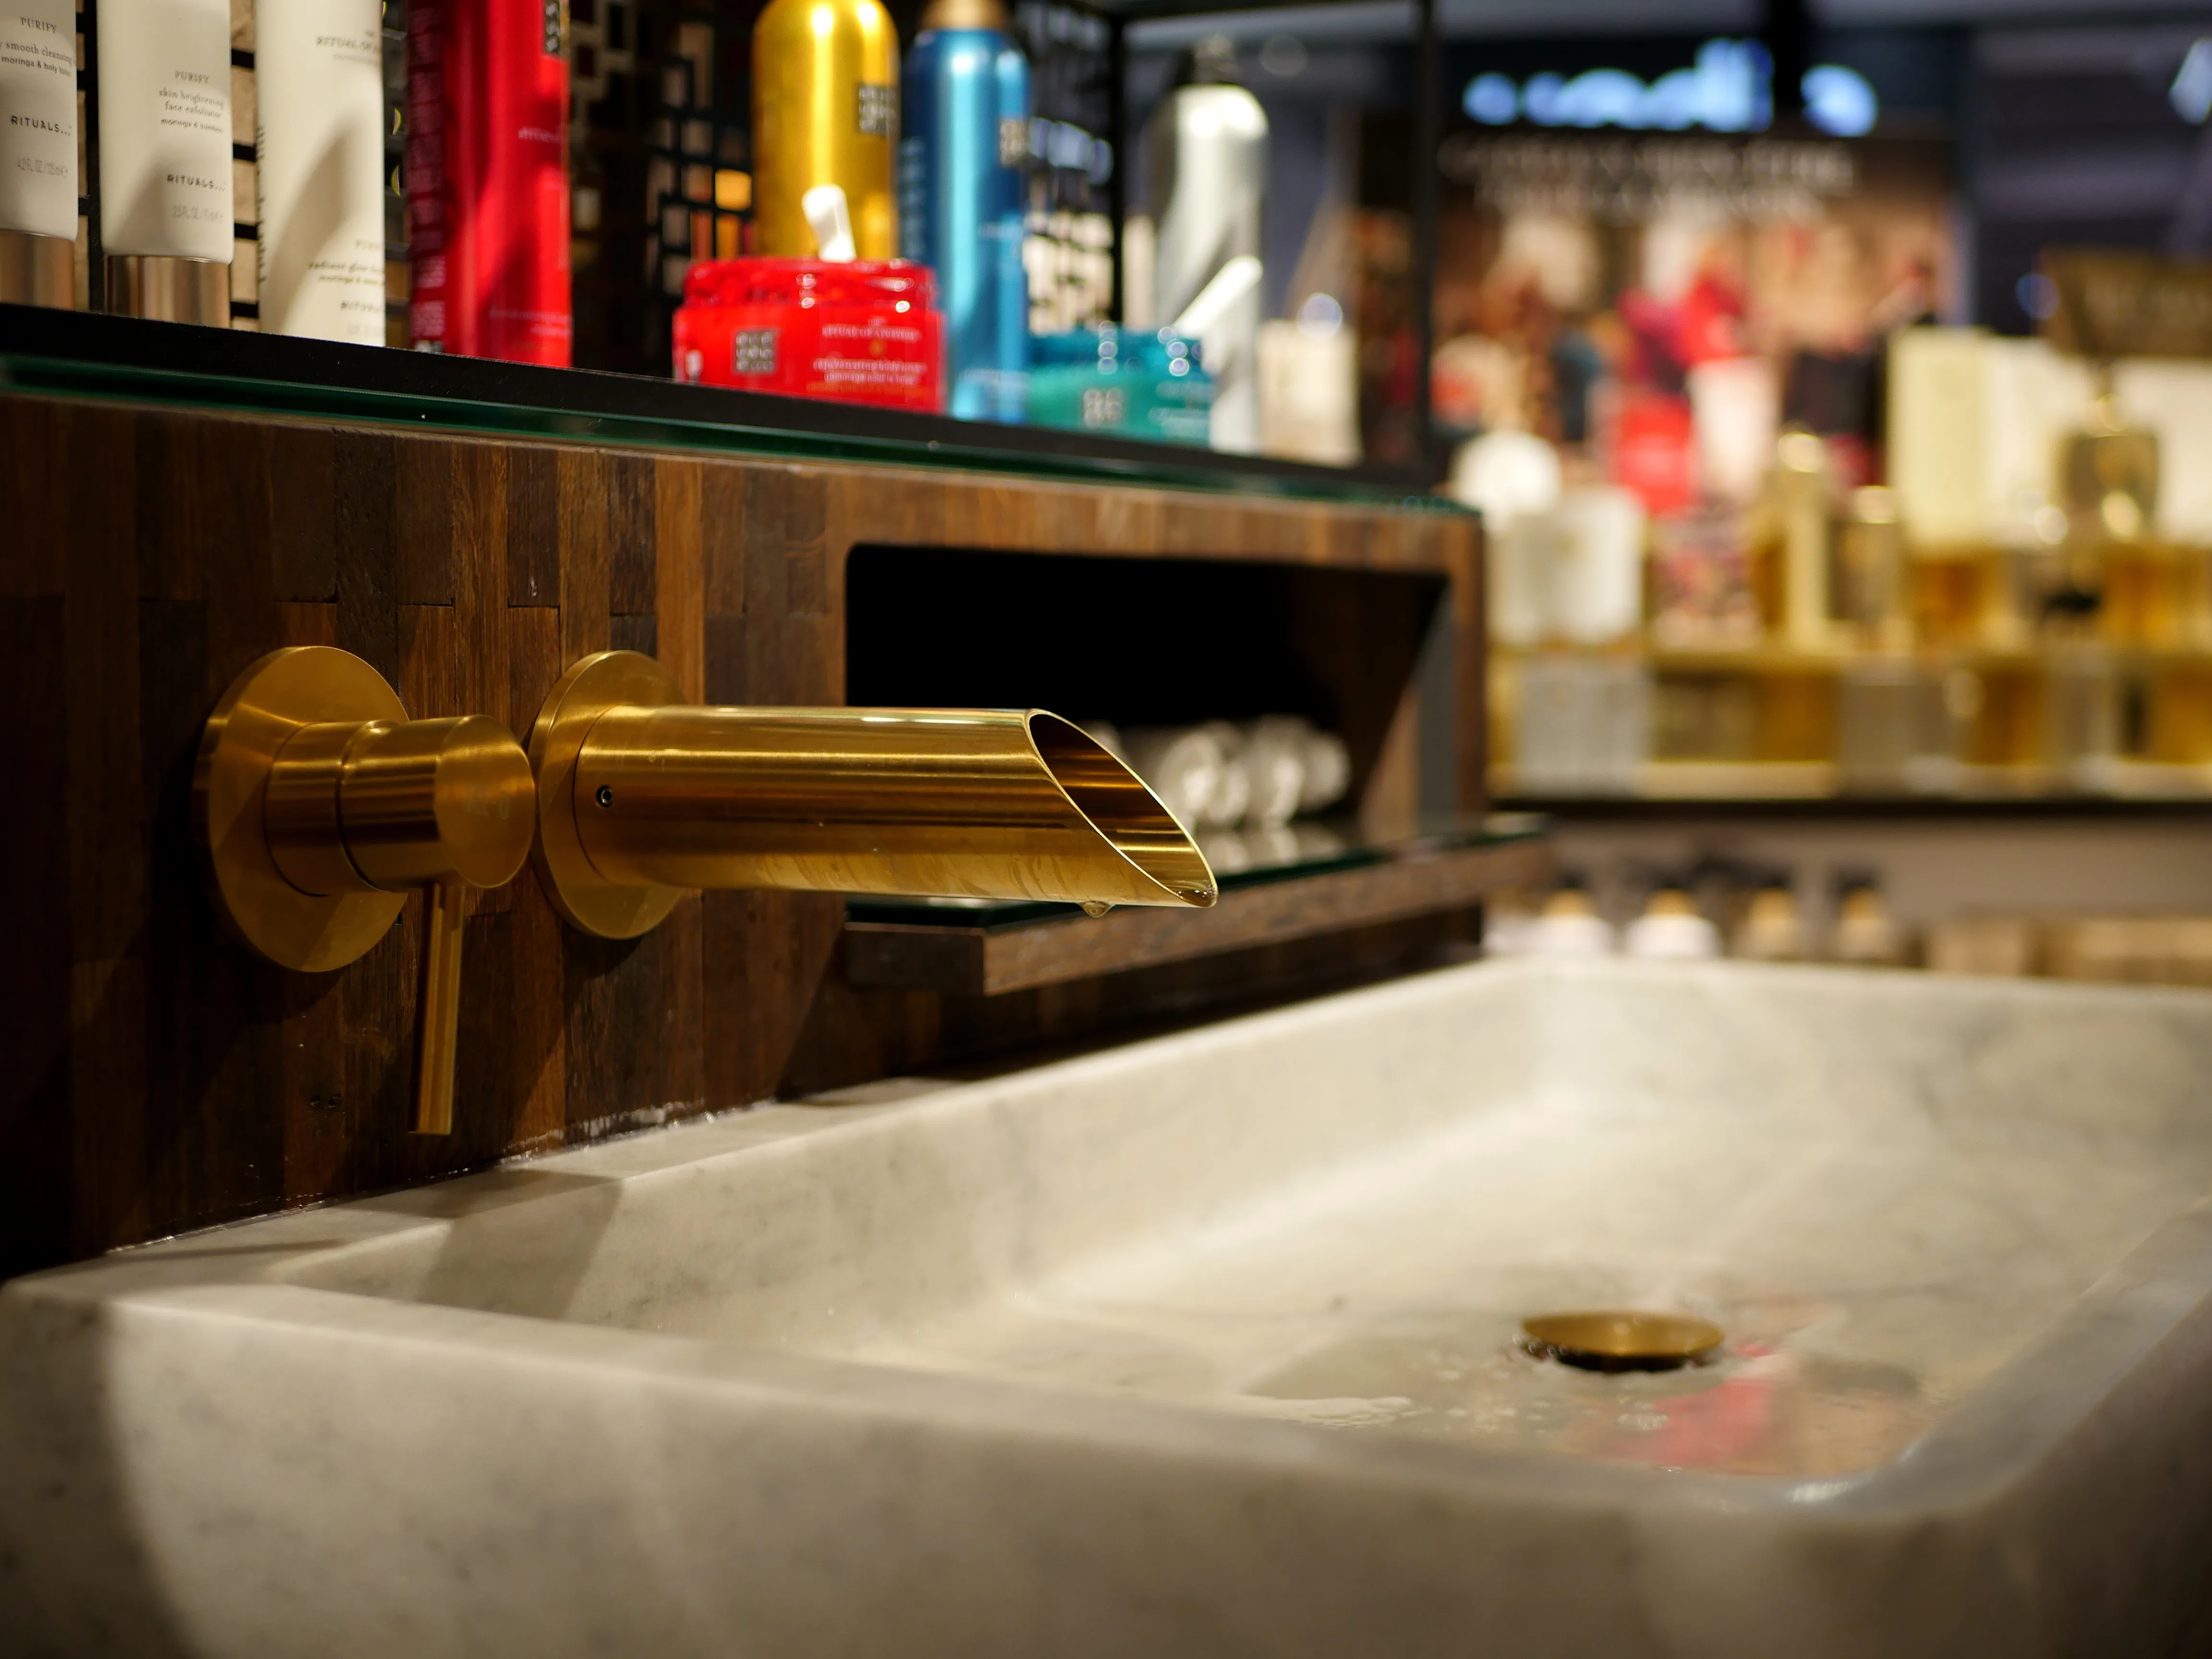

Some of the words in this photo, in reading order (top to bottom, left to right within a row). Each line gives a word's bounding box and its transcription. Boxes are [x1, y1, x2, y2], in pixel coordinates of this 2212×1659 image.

[21, 16, 57, 34] PURIFY
[6, 42, 39, 54] smooth
[42, 47, 72, 67] cleansing
[2, 56, 35, 68] moringa
[44, 62, 58, 73] holy
[175, 70, 210, 84] PURIFY
[158, 86, 178, 99] skin
[165, 100, 182, 112] face
